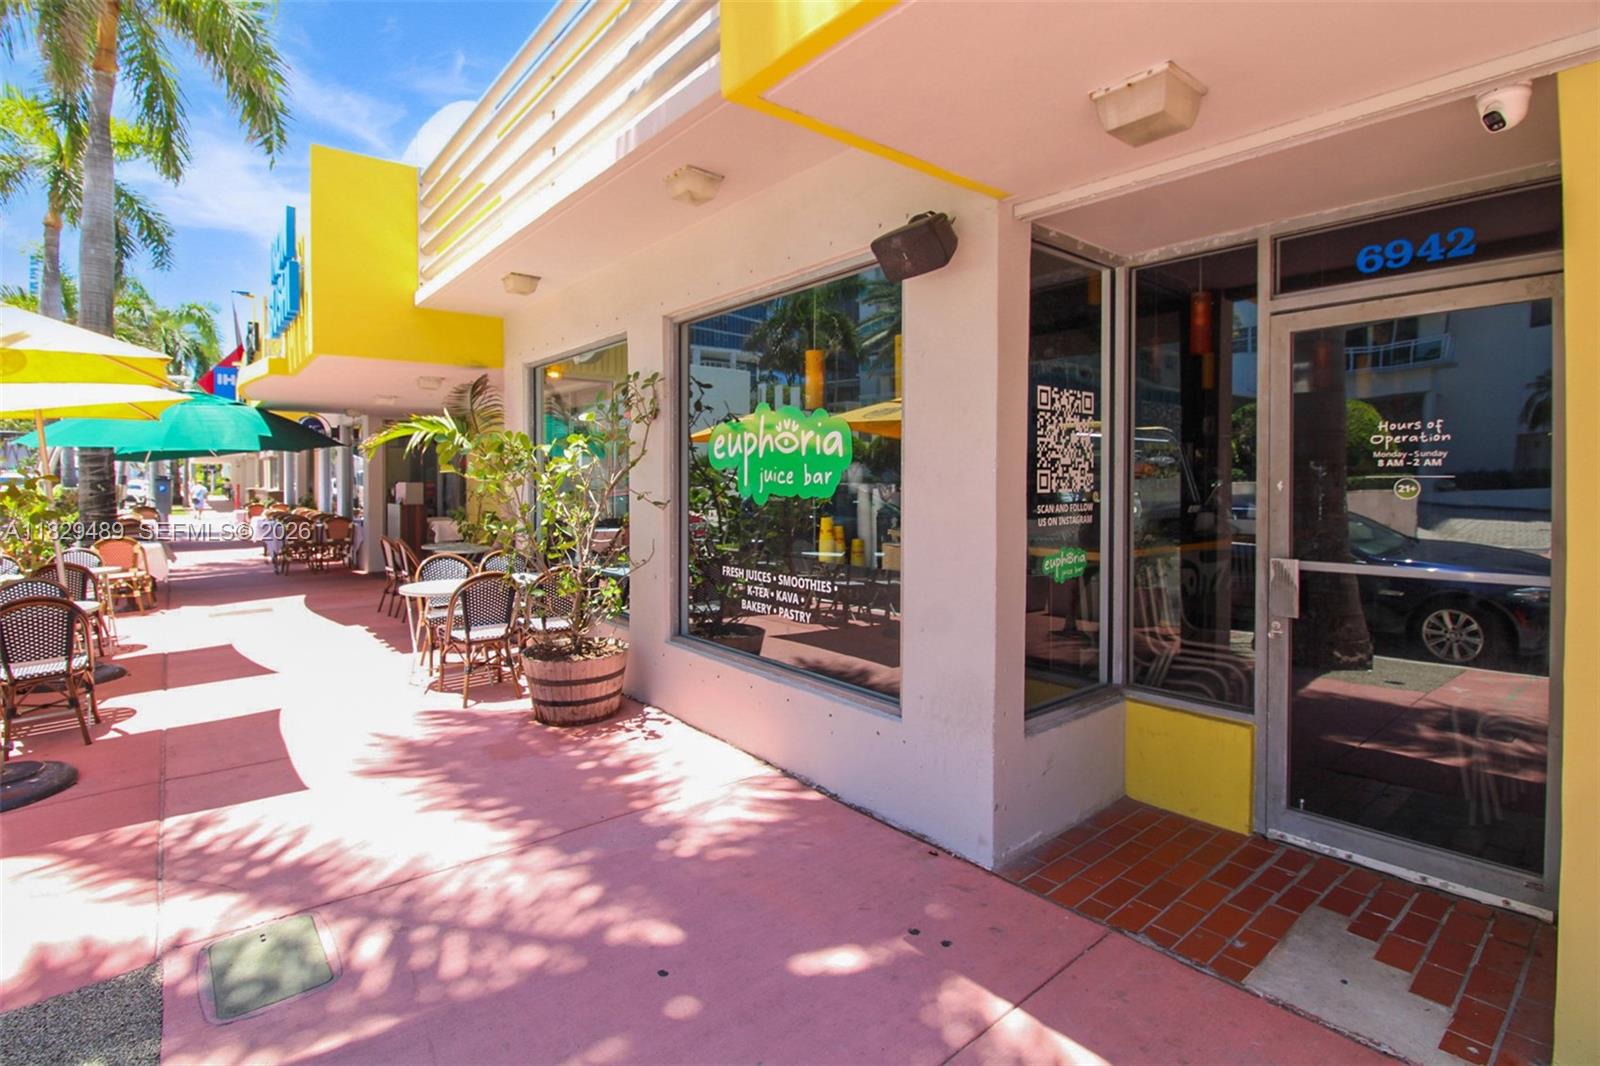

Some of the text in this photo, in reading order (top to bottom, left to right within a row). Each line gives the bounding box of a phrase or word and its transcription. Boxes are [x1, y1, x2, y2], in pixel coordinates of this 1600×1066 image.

[1355, 226, 1477, 274] 6942
[1377, 419, 1444, 433] Hours of
[1369, 432, 1452, 450] Operation
[713, 414, 844, 487] euphoria
[1372, 450, 1407, 459] Monday
[1414, 450, 1449, 459] Sunday
[1377, 459, 1385, 467] 8
[1386, 459, 1404, 467] AM
[1423, 458, 1443, 467] AM
[759, 464, 833, 493] juice bar
[1397, 484, 1418, 493] 21+
[1036, 502, 1094, 514] SCAN AND FOLLOW
[1037, 514, 1093, 527] US ON INSTAGRAM
[722, 565, 832, 593] FRESH JUICES SMOOTHIES
[775, 590, 800, 605] KAVA
[741, 599, 812, 623] BAKERY PASTRY
